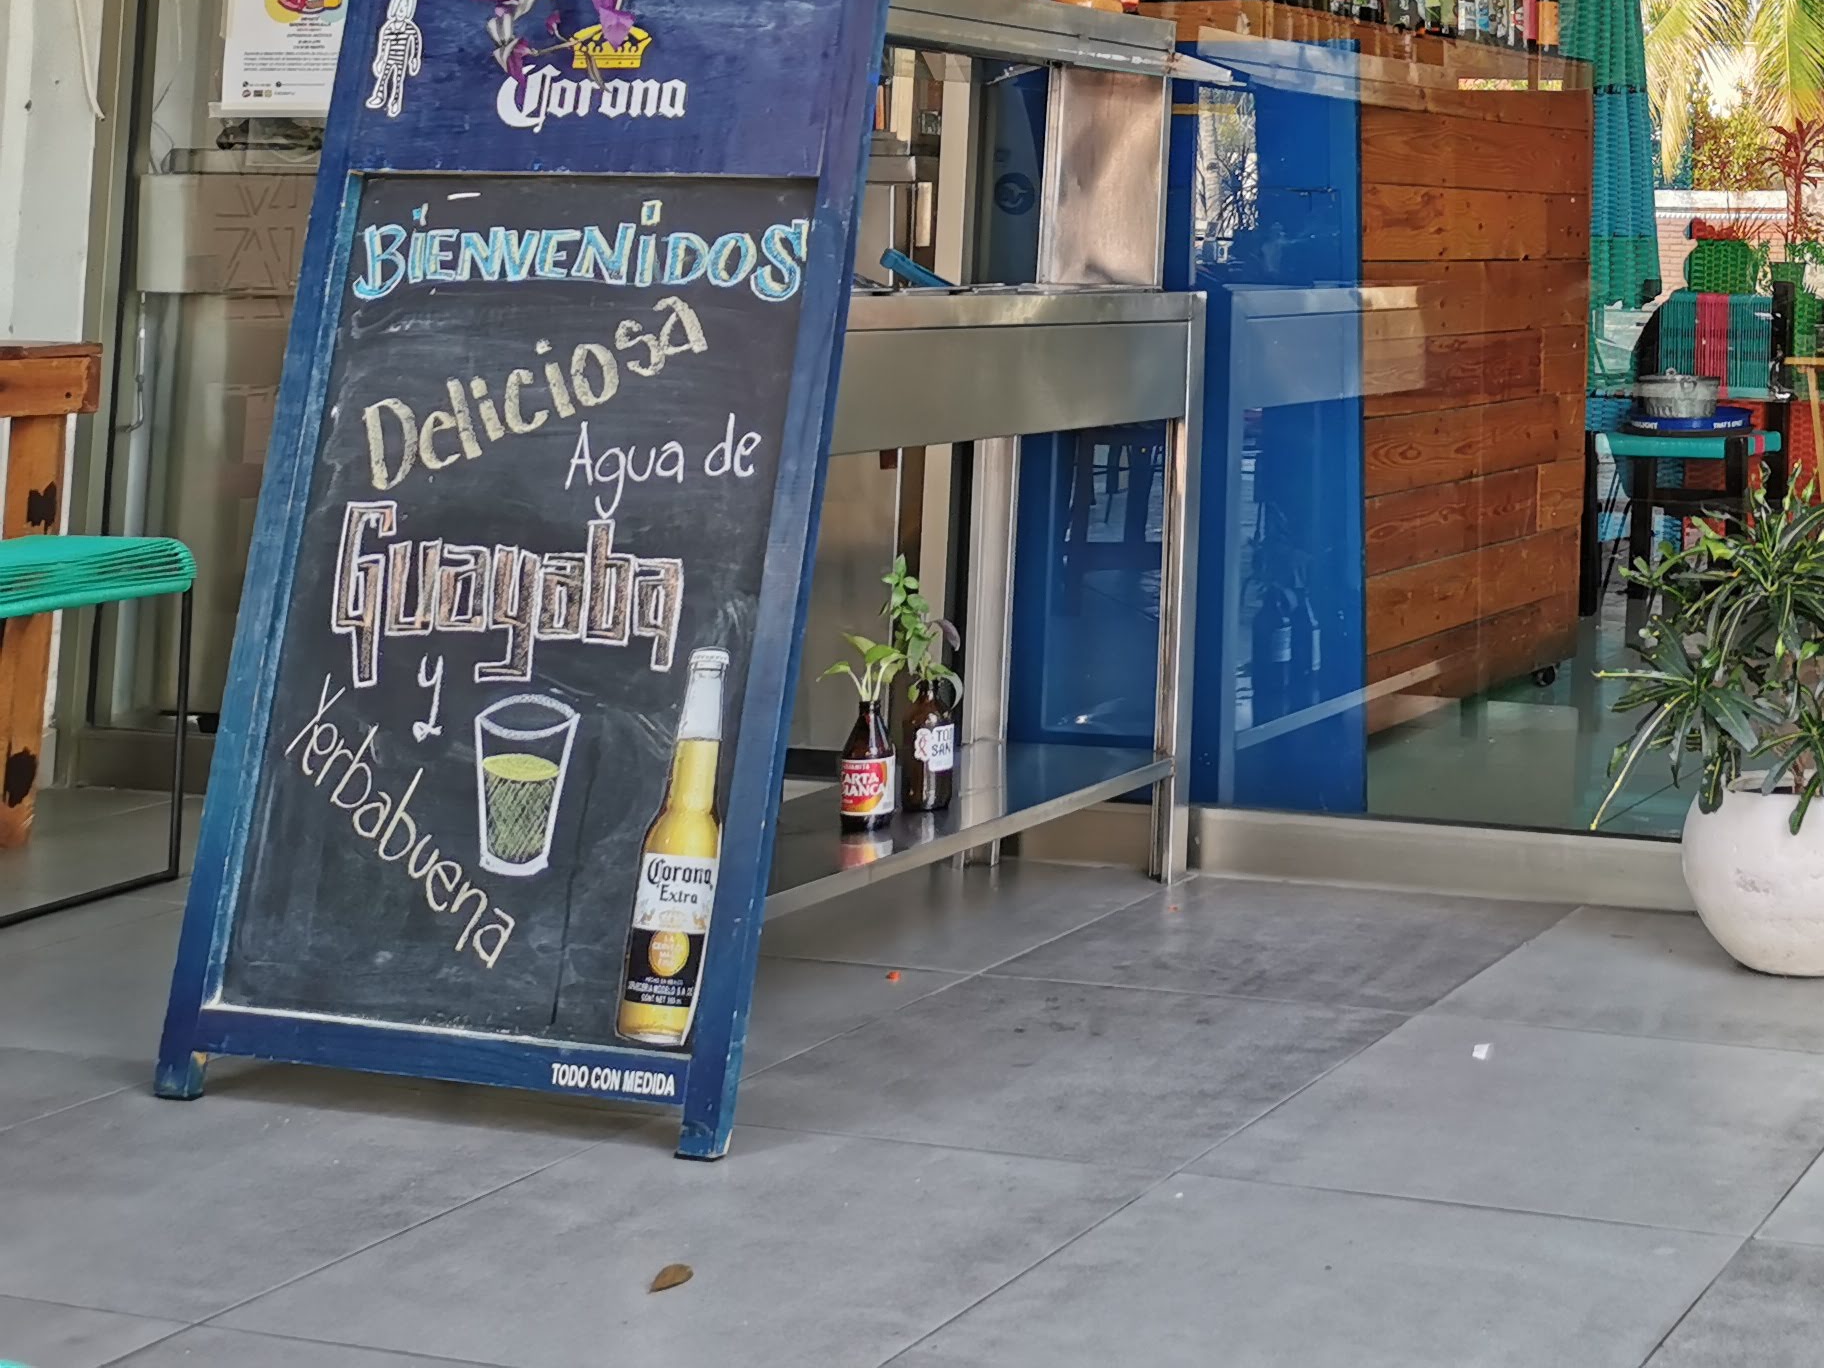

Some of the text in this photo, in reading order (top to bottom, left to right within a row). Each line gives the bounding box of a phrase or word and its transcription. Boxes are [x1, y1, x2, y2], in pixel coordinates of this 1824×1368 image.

[496, 63, 688, 134] Corona
[564, 413, 762, 521] Agua de
[329, 499, 686, 688] Guayaba
[413, 653, 442, 743] y
[646, 856, 714, 891] Corona
[656, 883, 699, 905] Extra
[551, 1061, 677, 1097] TODO CON MEDIDA
